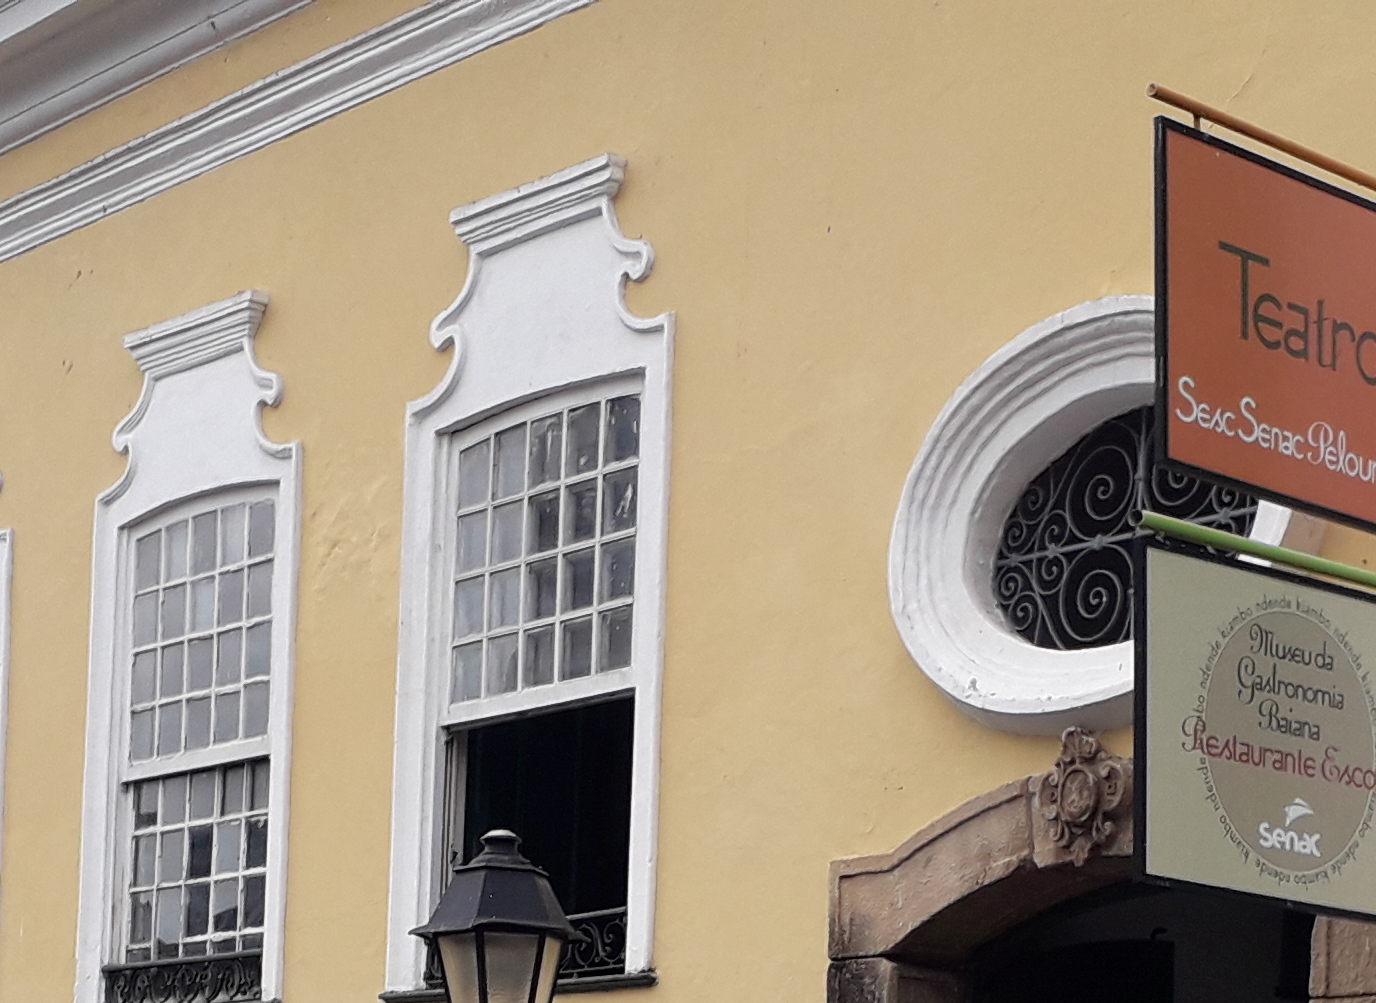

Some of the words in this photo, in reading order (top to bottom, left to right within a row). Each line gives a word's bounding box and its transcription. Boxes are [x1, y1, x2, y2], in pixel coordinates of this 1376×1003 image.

[1175, 375, 1236, 438] Sesc
[1236, 396, 1304, 460] Senac
[1249, 623, 1313, 667] Museu
[1314, 640, 1334, 671] da
[1237, 655, 1344, 710] Gastronomia
[1181, 715, 1316, 778] Restaurante
[1258, 699, 1320, 741] Baiana
